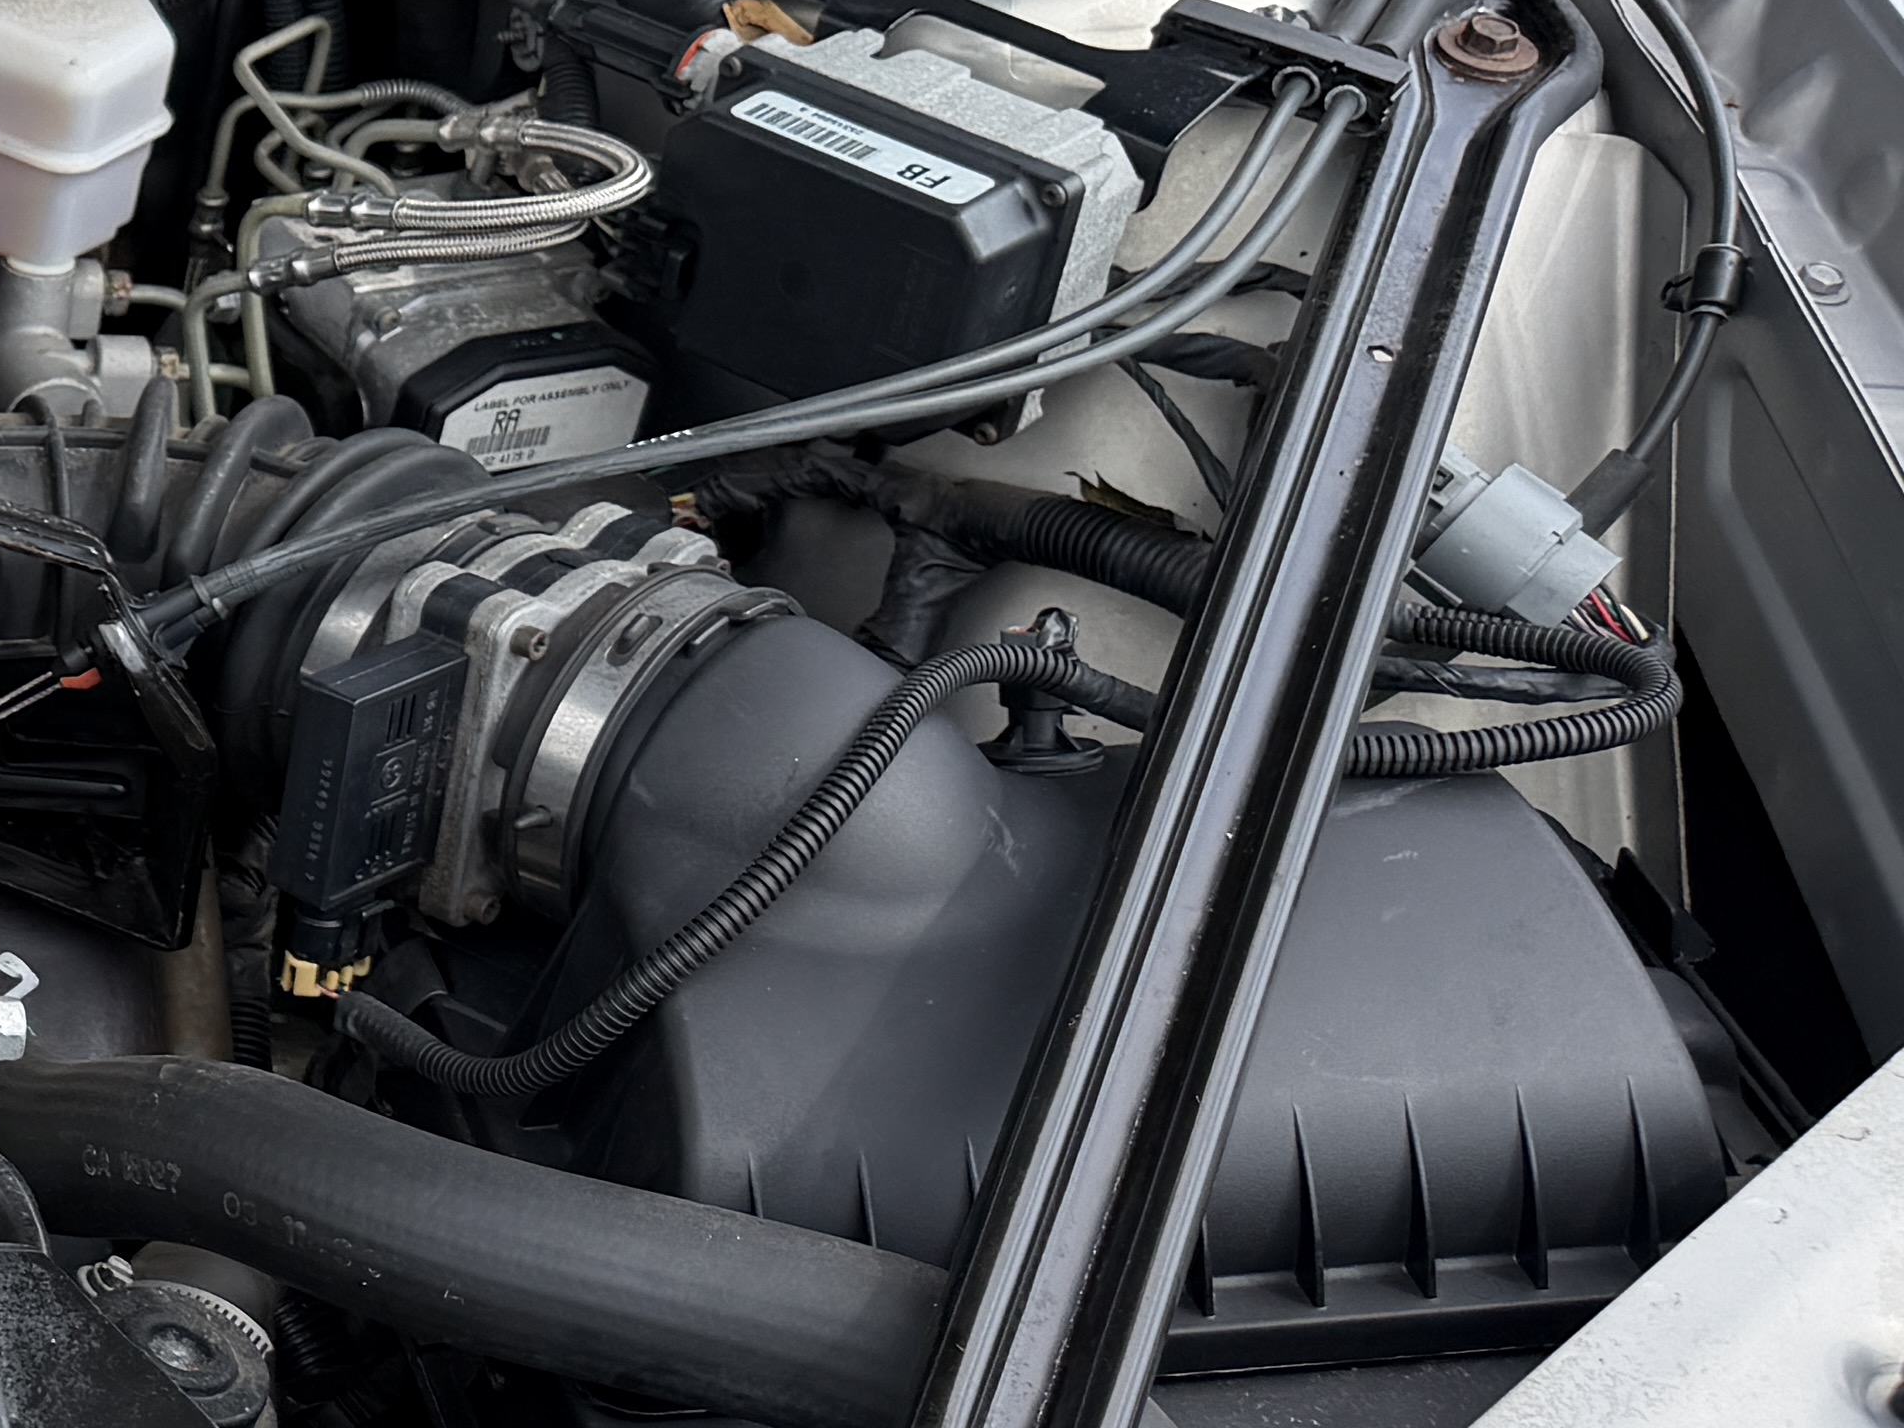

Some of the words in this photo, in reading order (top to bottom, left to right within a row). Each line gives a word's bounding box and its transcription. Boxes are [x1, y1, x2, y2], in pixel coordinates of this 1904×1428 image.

[474, 399, 509, 412] LABEL
[512, 394, 537, 405] FOR
[538, 384, 599, 402] ASSEMBLY
[600, 380, 631, 392] ONLY
